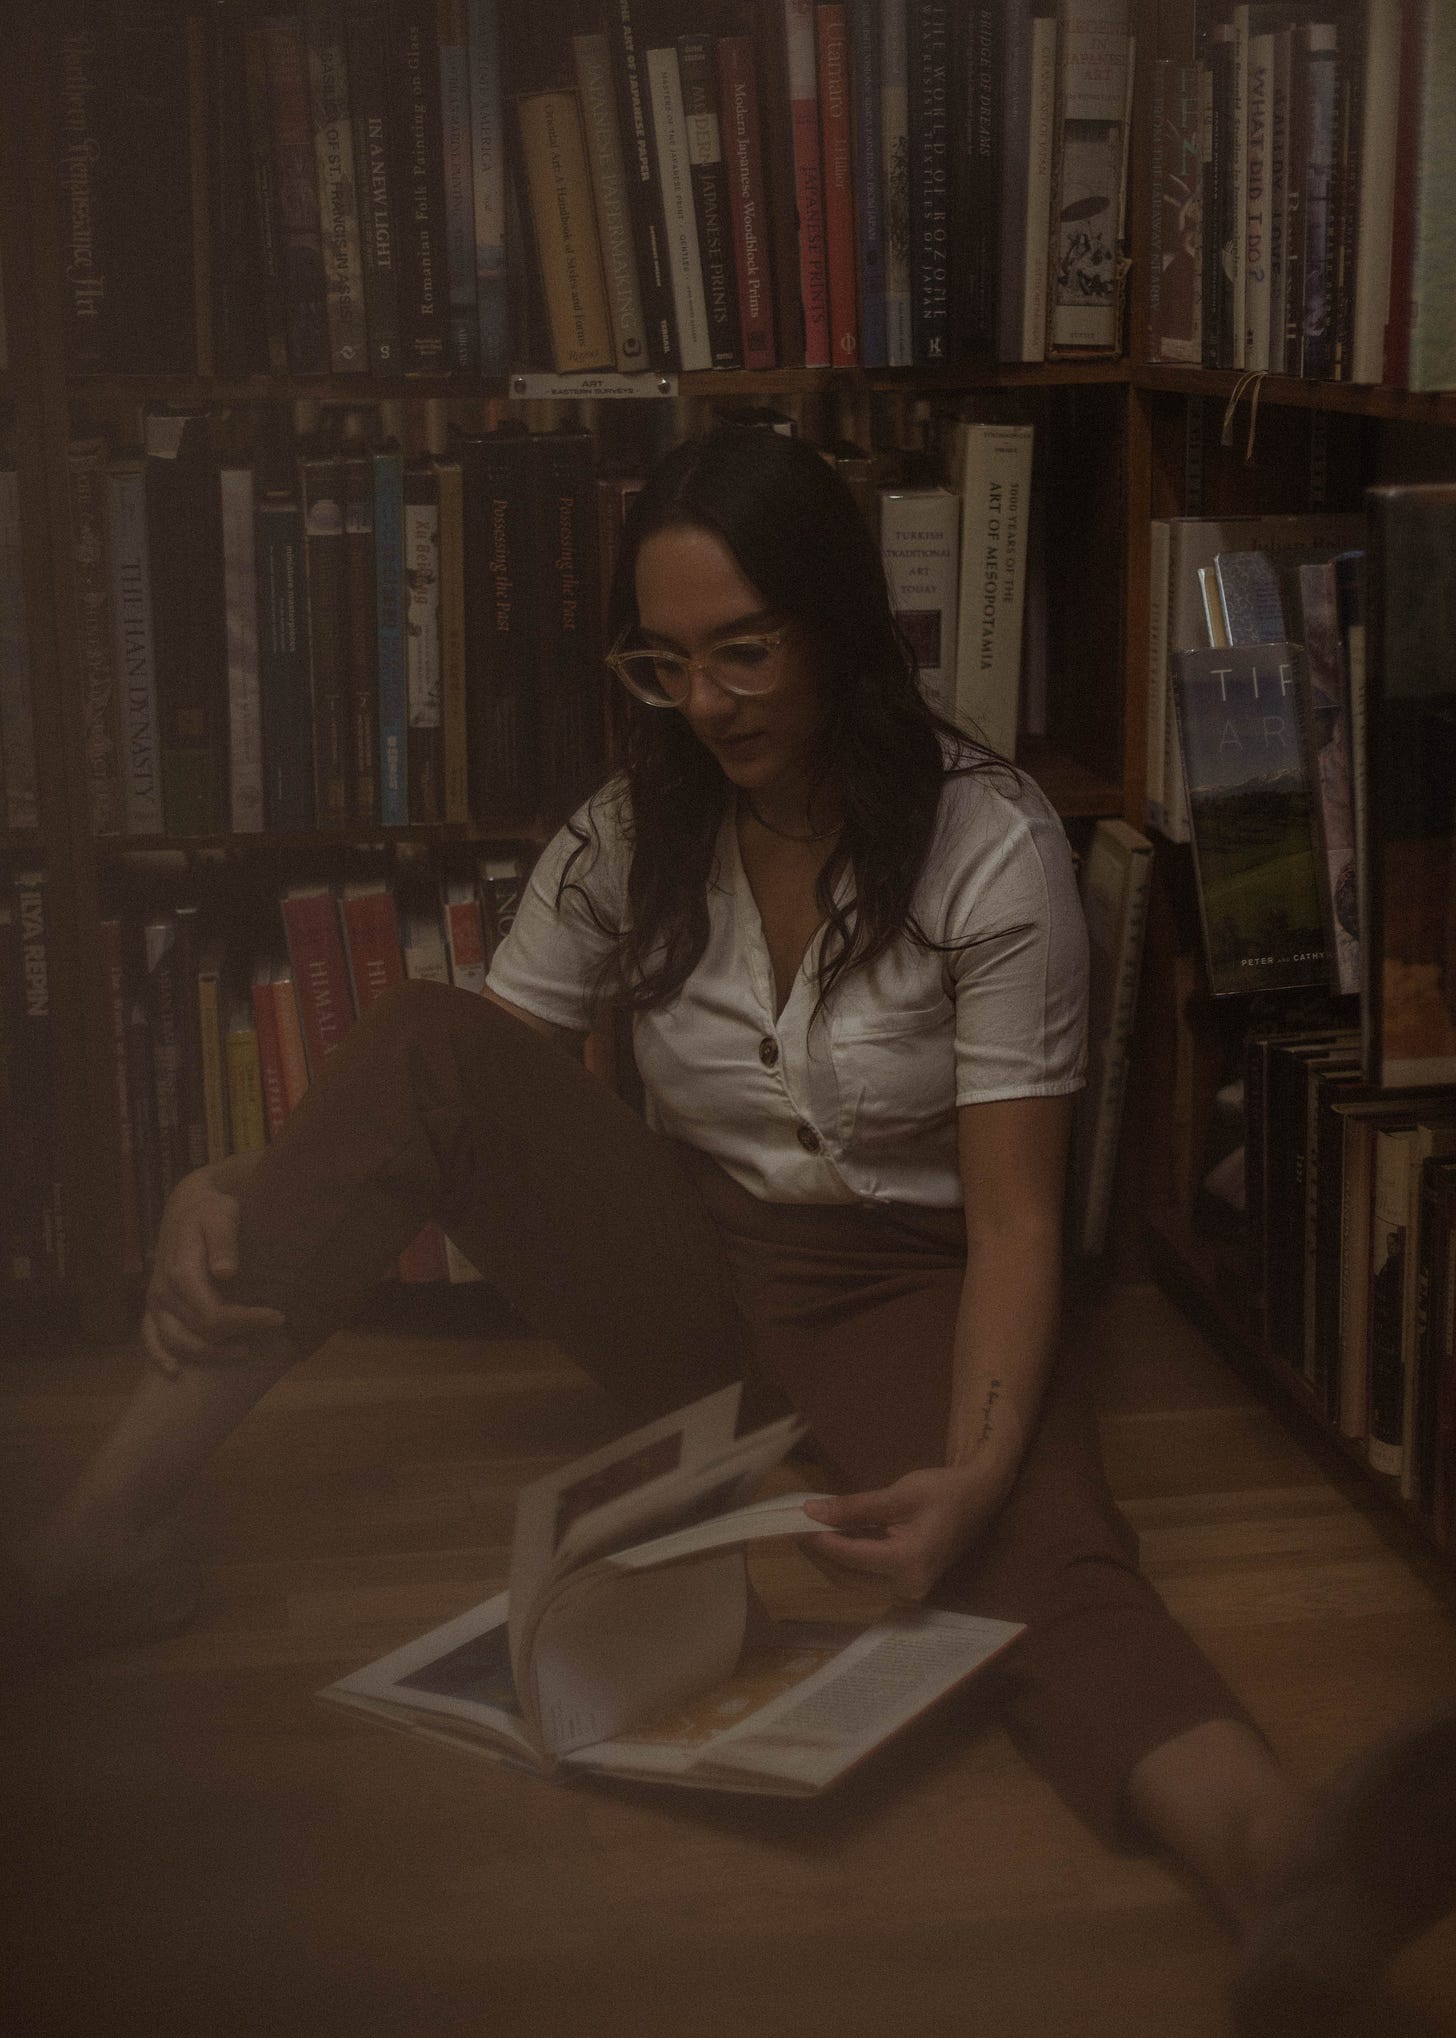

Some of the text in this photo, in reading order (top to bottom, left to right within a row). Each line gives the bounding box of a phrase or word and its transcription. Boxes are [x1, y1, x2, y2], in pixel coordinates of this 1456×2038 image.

[622, 25, 636, 53] ART
[933, 3, 946, 49] THE
[626, 55, 638, 72] OF
[826, 22, 846, 118] Utamaro
[979, 9, 992, 157] BRIDGE OF DREAMS
[544, 104, 561, 148] Oriental
[628, 74, 645, 139] JAPANESE
[691, 86, 712, 167] MODERN
[933, 65, 946, 154] WORLD
[1250, 68, 1265, 151] WHAT
[327, 129, 340, 151] OF
[478, 102, 493, 173] AMERICA
[660, 71, 685, 220] MASTERS OF THE JAPANESE PRINT
[864, 129, 875, 180] PAINTINGS
[329, 154, 342, 177] ST.
[406, 26, 434, 315] Romanian Folk Painting on Glass
[550, 152, 564, 172] Art:
[554, 175, 564, 183] A
[636, 140, 651, 182] PAPER
[922, 4, 933, 320] WAX-RESIST TEXTILES OF JAPAN
[933, 169, 946, 194] OF
[1249, 160, 1264, 201] DID
[60, 139, 101, 268] Renaissance
[331, 182, 347, 248] FRANCIS
[368, 117, 393, 270] IN A NEW LIGHT
[556, 187, 573, 243] Handbook
[585, 62, 637, 330] JAPANESE PAPERMAKING
[698, 173, 722, 259] JAPANESE
[733, 82, 761, 319] Modern Japanese Woodblock Prints
[866, 181, 877, 209] FROM
[1149, 97, 1164, 311] FROM THE FARAWAY NEARBY
[866, 210, 878, 241] JAPAN
[1248, 212, 1263, 226] I
[336, 252, 349, 269] IN
[801, 166, 826, 324] JAPANESE PRINTS
[66, 267, 105, 317] Art
[565, 256, 580, 289] Styles
[709, 264, 728, 324] PRINTS
[338, 273, 352, 324] ASSISI
[572, 292, 584, 312] and
[573, 314, 588, 347] Forms
[551, 387, 634, 396] EASTERN SURVEYS
[581, 380, 604, 388] ART
[414, 520, 430, 540] Xu
[895, 531, 944, 541] TURKISH
[1004, 516, 1017, 554] YEARS
[489, 498, 514, 632] Possessing the Past
[554, 496, 580, 632] Possessing the Past
[886, 549, 951, 558] TRADITIONAL
[908, 567, 930, 577] ART
[980, 481, 1002, 672] ART OF MESOPOTAMIA
[1003, 558, 1016, 577] OF
[285, 545, 298, 653] miniature masterpieces
[900, 585, 938, 594] TODAY
[1002, 581, 1014, 604] THE
[120, 561, 156, 802] THE HAN DYNASTY
[1219, 715, 1287, 753] AR
[20, 892, 50, 1016] ILYA REPIN
[1241, 956, 1274, 967] PETER
[1292, 951, 1325, 962] CATHY
